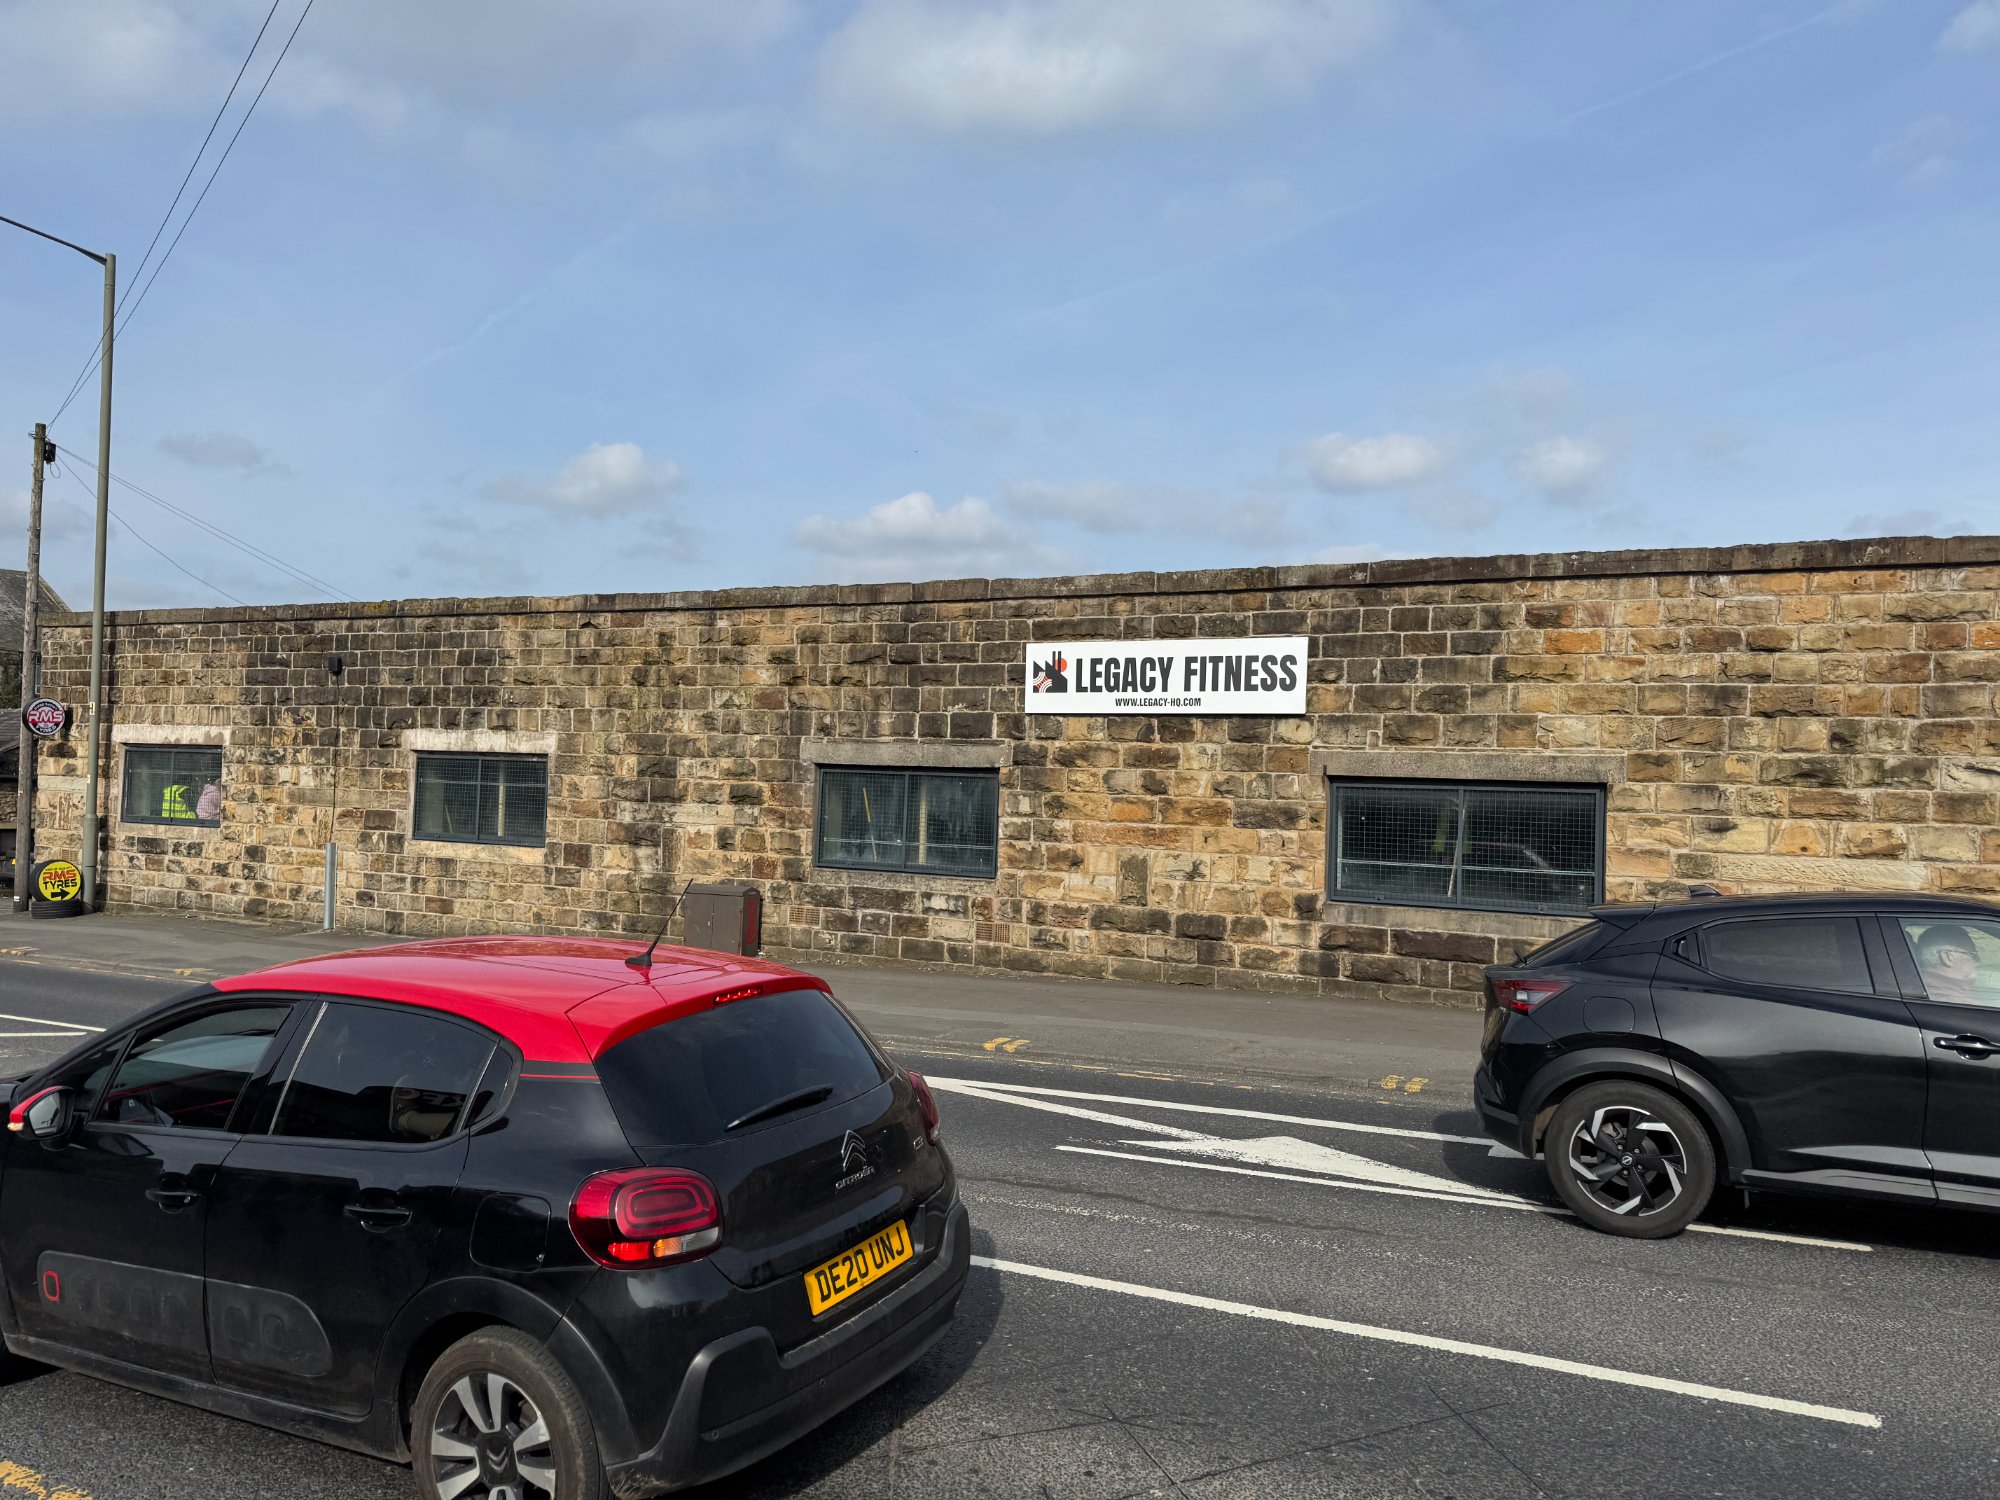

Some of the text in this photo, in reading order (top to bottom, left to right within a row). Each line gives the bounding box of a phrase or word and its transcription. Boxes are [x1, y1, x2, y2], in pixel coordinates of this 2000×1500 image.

[1075, 654, 1298, 693] LEGACY FITNESS
[1115, 697, 1202, 707] WWW.LEGACY-HQ.COM
[29, 710, 63, 722] RMS
[42, 869, 77, 881] RMS
[42, 878, 78, 890] TYRES
[814, 1227, 905, 1303] DE20 UNJ
